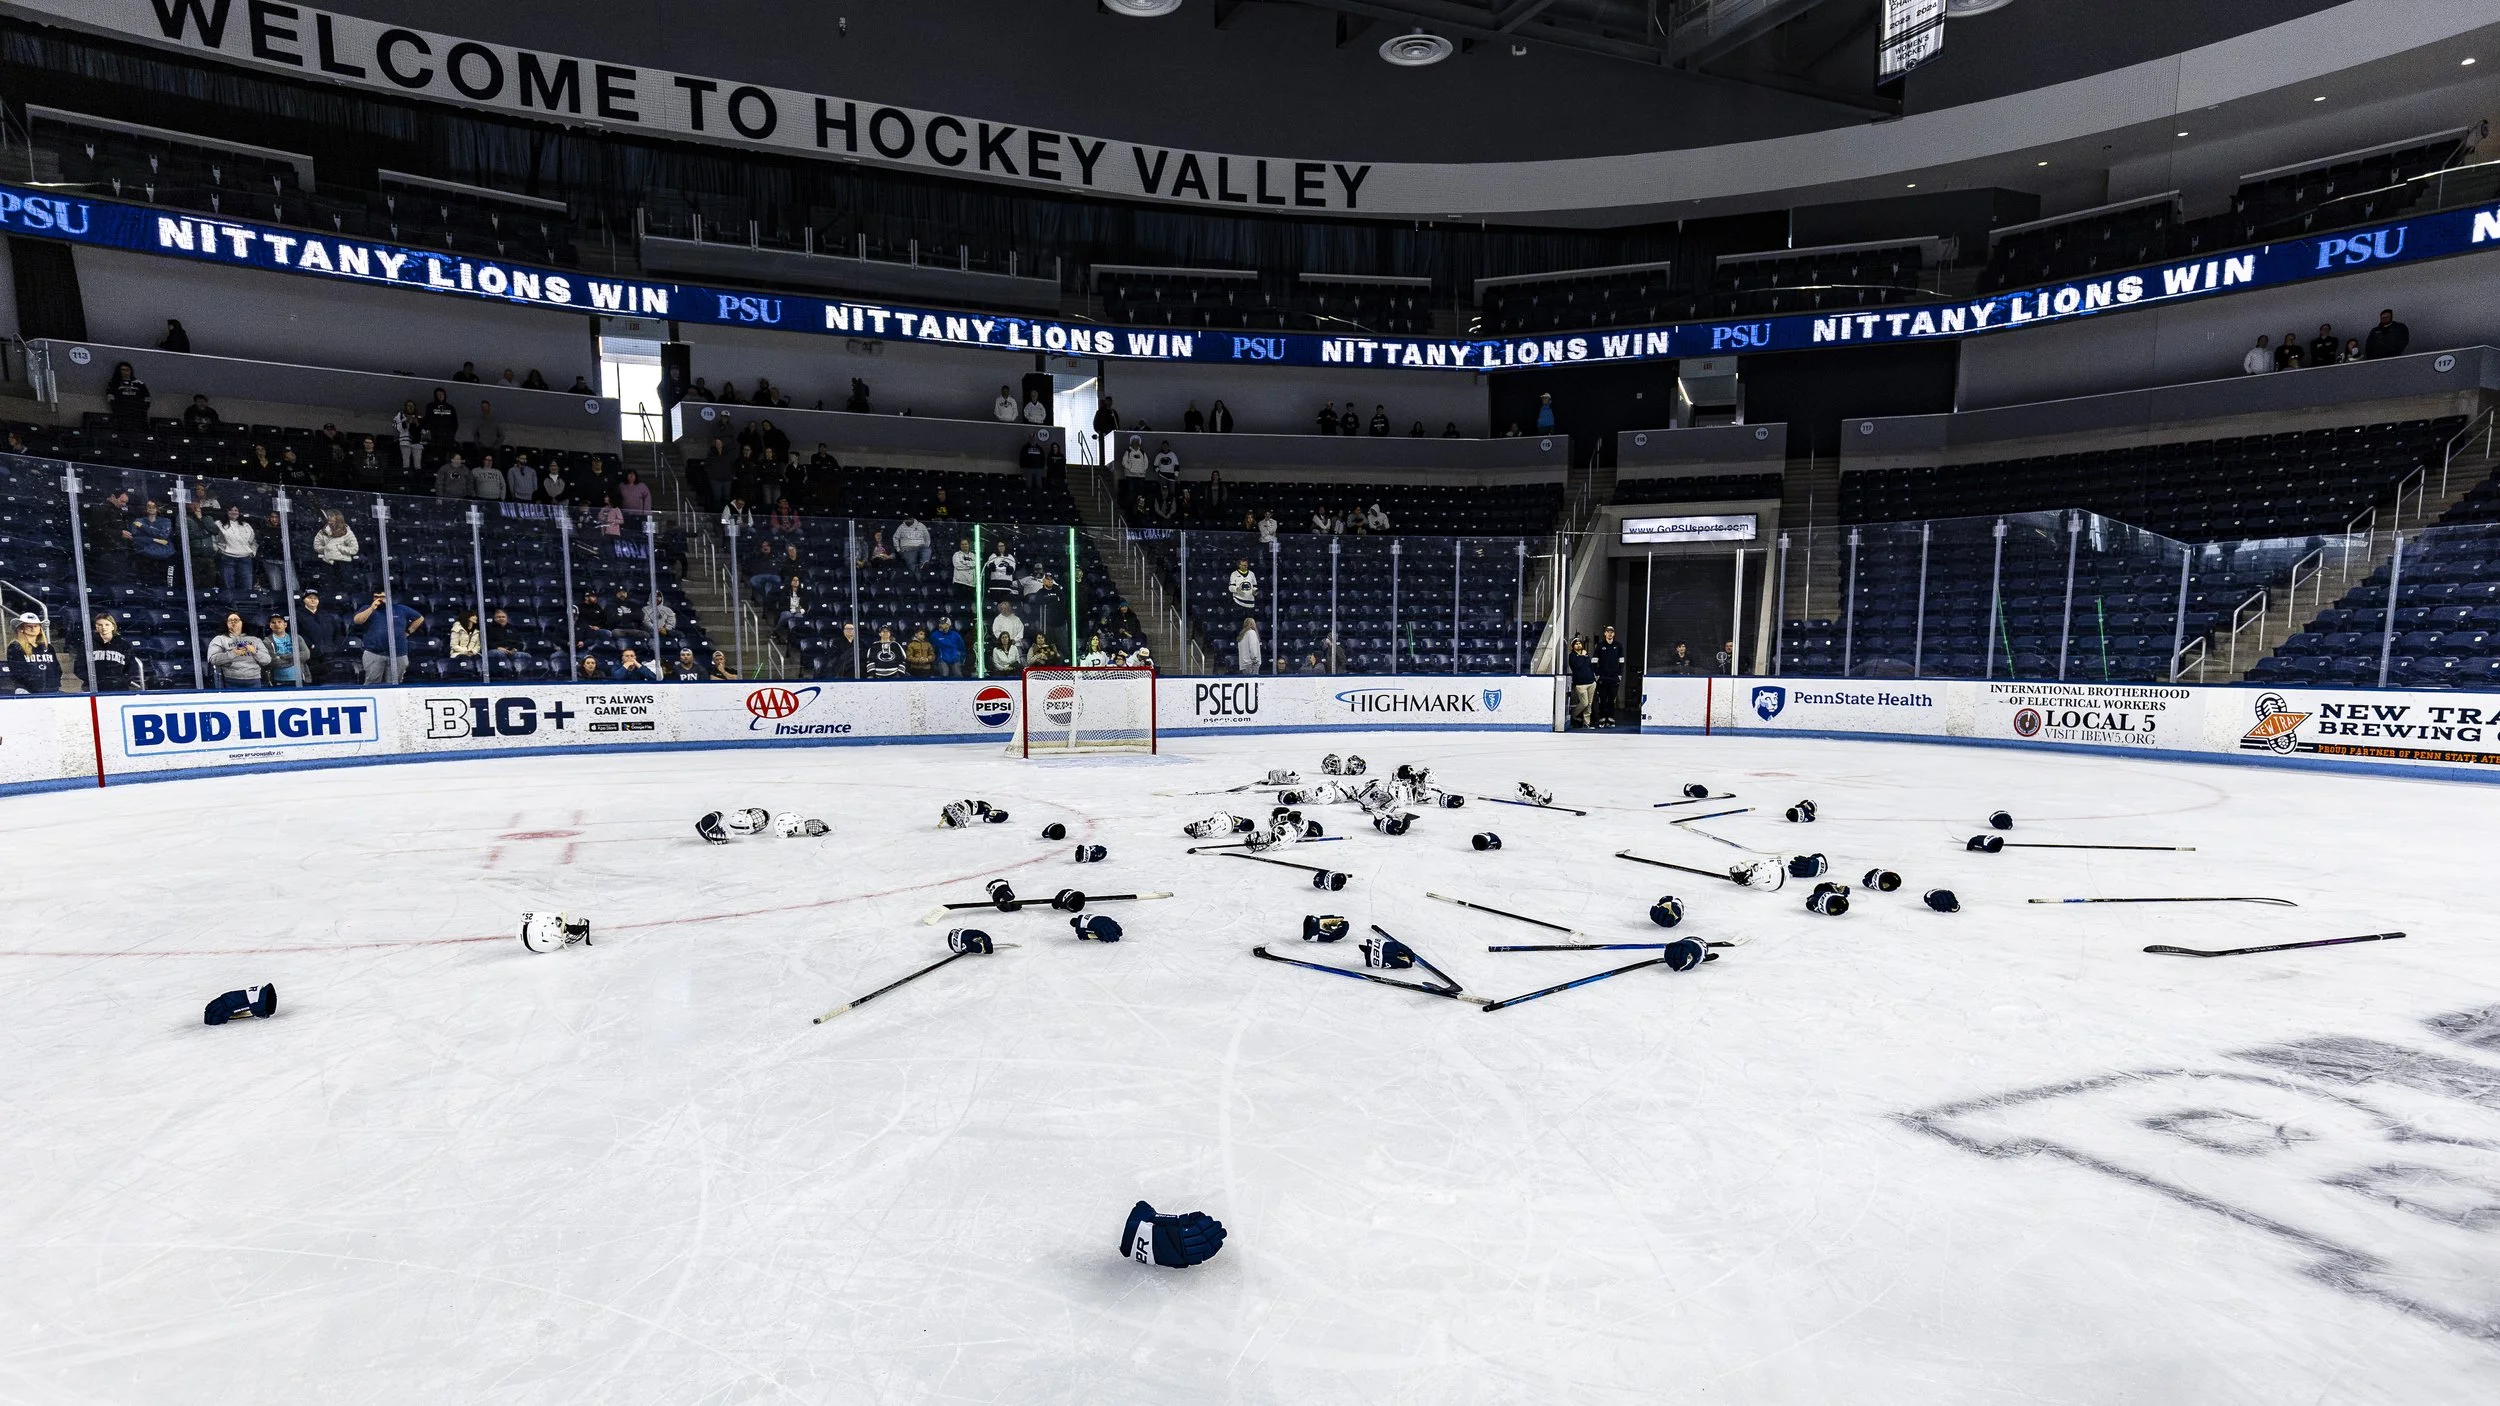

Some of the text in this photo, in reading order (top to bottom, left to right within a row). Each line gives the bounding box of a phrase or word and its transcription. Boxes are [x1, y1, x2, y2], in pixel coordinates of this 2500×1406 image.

[1895, 33, 1930, 54] WOMEN'S
[1897, 43, 1927, 61] HOCKEY
[153, 0, 1371, 209] WELCOME TO HOCKEY VALLEY
[2315, 226, 2408, 270] PSU
[158, 217, 408, 280] NITTANY
[428, 258, 571, 302] LIONS
[717, 294, 782, 324] PSU
[1812, 302, 1996, 343] NITTANY
[2010, 275, 2144, 322] LIONS
[825, 305, 997, 342] NITTANY
[1009, 322, 1115, 354] LIONS
[1711, 323, 1771, 350] PSU
[72, 352, 89, 361] 113
[1231, 337, 1286, 360] PSU
[1322, 339, 1471, 366] NITTANY
[1484, 337, 1588, 366] LIONS
[2438, 359, 2453, 367] 117
[586, 696, 654, 704] IT'S ALWAYS
[1196, 683, 1258, 715] PSECU
[1878, 693, 1932, 707] Health
[1990, 684, 2190, 699] INTERNATIONAL BROTHERHOOD
[594, 706, 647, 715] GAME ON
[752, 688, 794, 718] AAA
[976, 702, 1011, 711] PEPSI
[1351, 694, 1475, 712] HIGHMARK
[2009, 697, 2166, 711] OF ELECTRICAL WORKERS
[2320, 703, 2410, 721] NEW
[132, 705, 368, 746] BUD LIGHT
[775, 723, 851, 734] Insurance
[2045, 710, 2135, 731] LOCAL
[2142, 714, 2156, 733] 5
[2255, 714, 2301, 735] NEW TRAIL
[2318, 721, 2482, 741] BREWING
[2045, 728, 2156, 745] VISIT IBEW5.ORG
[2318, 744, 2347, 754] PROUD
[2350, 746, 2396, 757] PARTNER
[2399, 750, 2411, 758] OF
[2414, 751, 2442, 760] PENN
[2445, 753, 2478, 762] STATE
